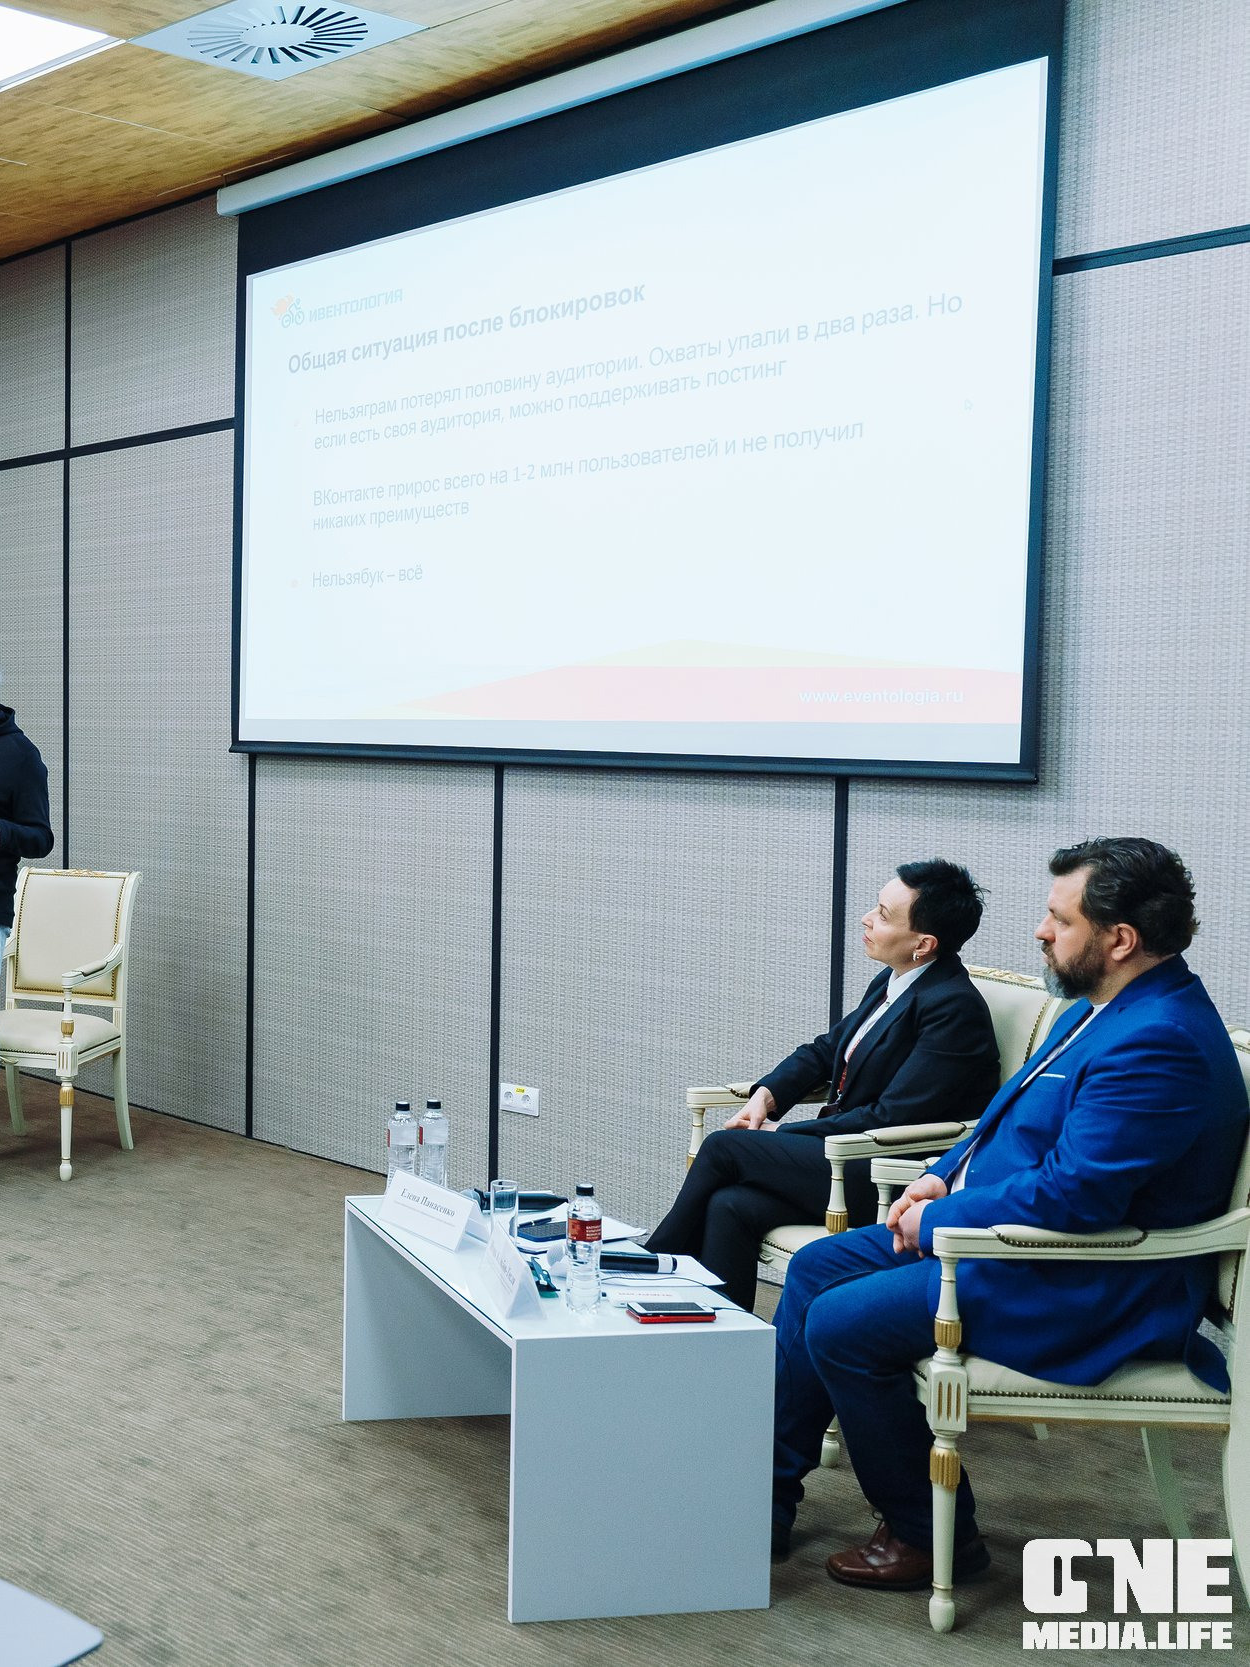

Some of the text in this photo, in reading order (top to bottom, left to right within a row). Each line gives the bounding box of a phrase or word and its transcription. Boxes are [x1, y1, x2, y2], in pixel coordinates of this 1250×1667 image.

[288, 284, 646, 374] Общая ситуация после блокировок
[309, 288, 403, 322] ИВЕНТОЛОГИЯ
[315, 293, 963, 425] Нельзяграм потерял половину аудитории. Охваты упали в два раза. Но
[314, 360, 787, 450] если есть своя аудитория, можно поддерживать постинг
[314, 421, 864, 506] ВКонтакте прирос всего на 1-2 млн пользователей и не получил
[313, 501, 470, 531] никаких преимуществ
[312, 567, 384, 588] Нельзябук
[399, 563, 423, 582] всё
[799, 689, 964, 705] www.eventologia.ru
